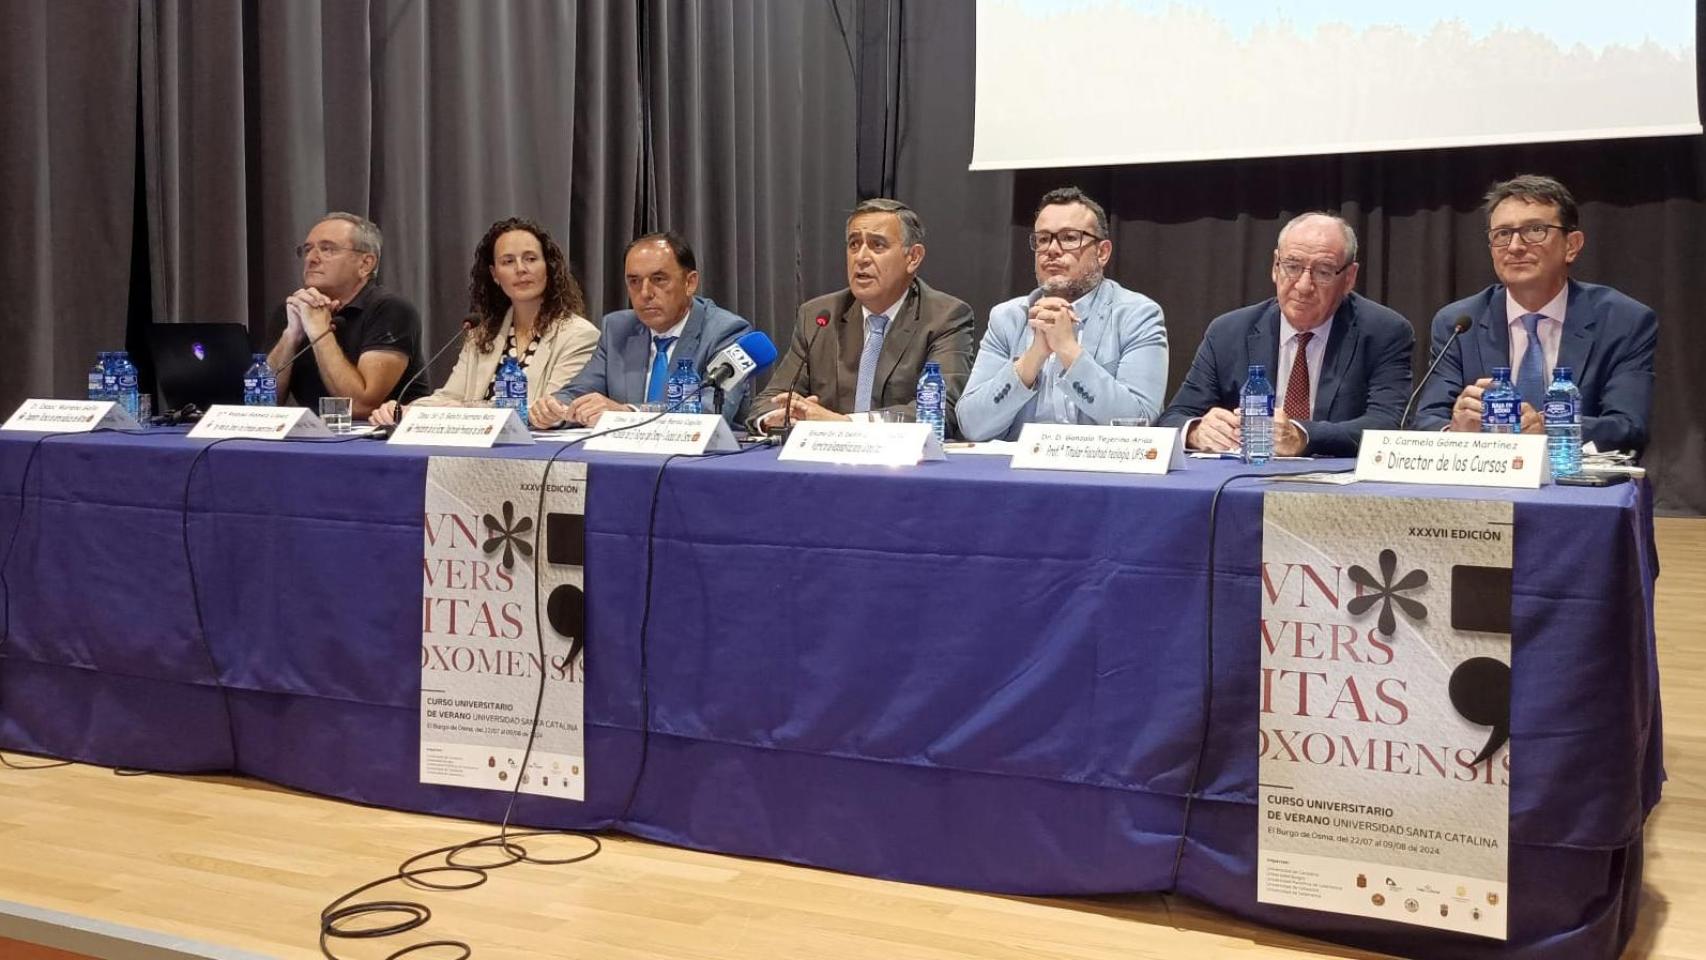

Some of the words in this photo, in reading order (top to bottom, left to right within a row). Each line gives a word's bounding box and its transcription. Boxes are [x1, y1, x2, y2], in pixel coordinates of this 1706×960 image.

[1382, 436, 1392, 445] D.
[1395, 436, 1434, 447] Carmelo
[1436, 438, 1469, 448] Gómez
[1472, 439, 1519, 450] Martínez
[1387, 450, 1434, 470] Director
[1435, 452, 1449, 471] de
[1452, 452, 1468, 472] los
[1470, 455, 1508, 474] Cursos
[1408, 527, 1448, 539] XXXVII
[1450, 528, 1501, 541] EDICIÓN
[423, 559, 514, 593] VERS
[423, 597, 524, 640] ITAS
[1261, 619, 1394, 666] VERS
[427, 697, 454, 706] CURSO
[454, 700, 514, 712] UNIVERSITARIO
[1260, 668, 1409, 726] ITAS
[427, 709, 437, 718] DE
[439, 711, 472, 720] VERANO
[473, 714, 520, 725] UNIVERSIDAD
[545, 719, 579, 731] CATALINA
[1266, 794, 1304, 807] CURSO
[1306, 799, 1394, 818] UNIVERSITARIO
[1267, 810, 1281, 821] DE
[1284, 812, 1331, 826] VERANO
[1333, 817, 1404, 836] UNIVERSIDAD
[1405, 826, 1442, 841] SANTA
[1444, 832, 1499, 849] CATALINA
[1267, 826, 1275, 834] El
[1276, 826, 1299, 838] Burgo
[1300, 828, 1310, 838] de
[1336, 834, 1349, 843] del
[1350, 836, 1373, 847] 22/07
[1374, 838, 1382, 847] al
[1382, 839, 1407, 851] 09/08
[1419, 845, 1441, 855] 2024
